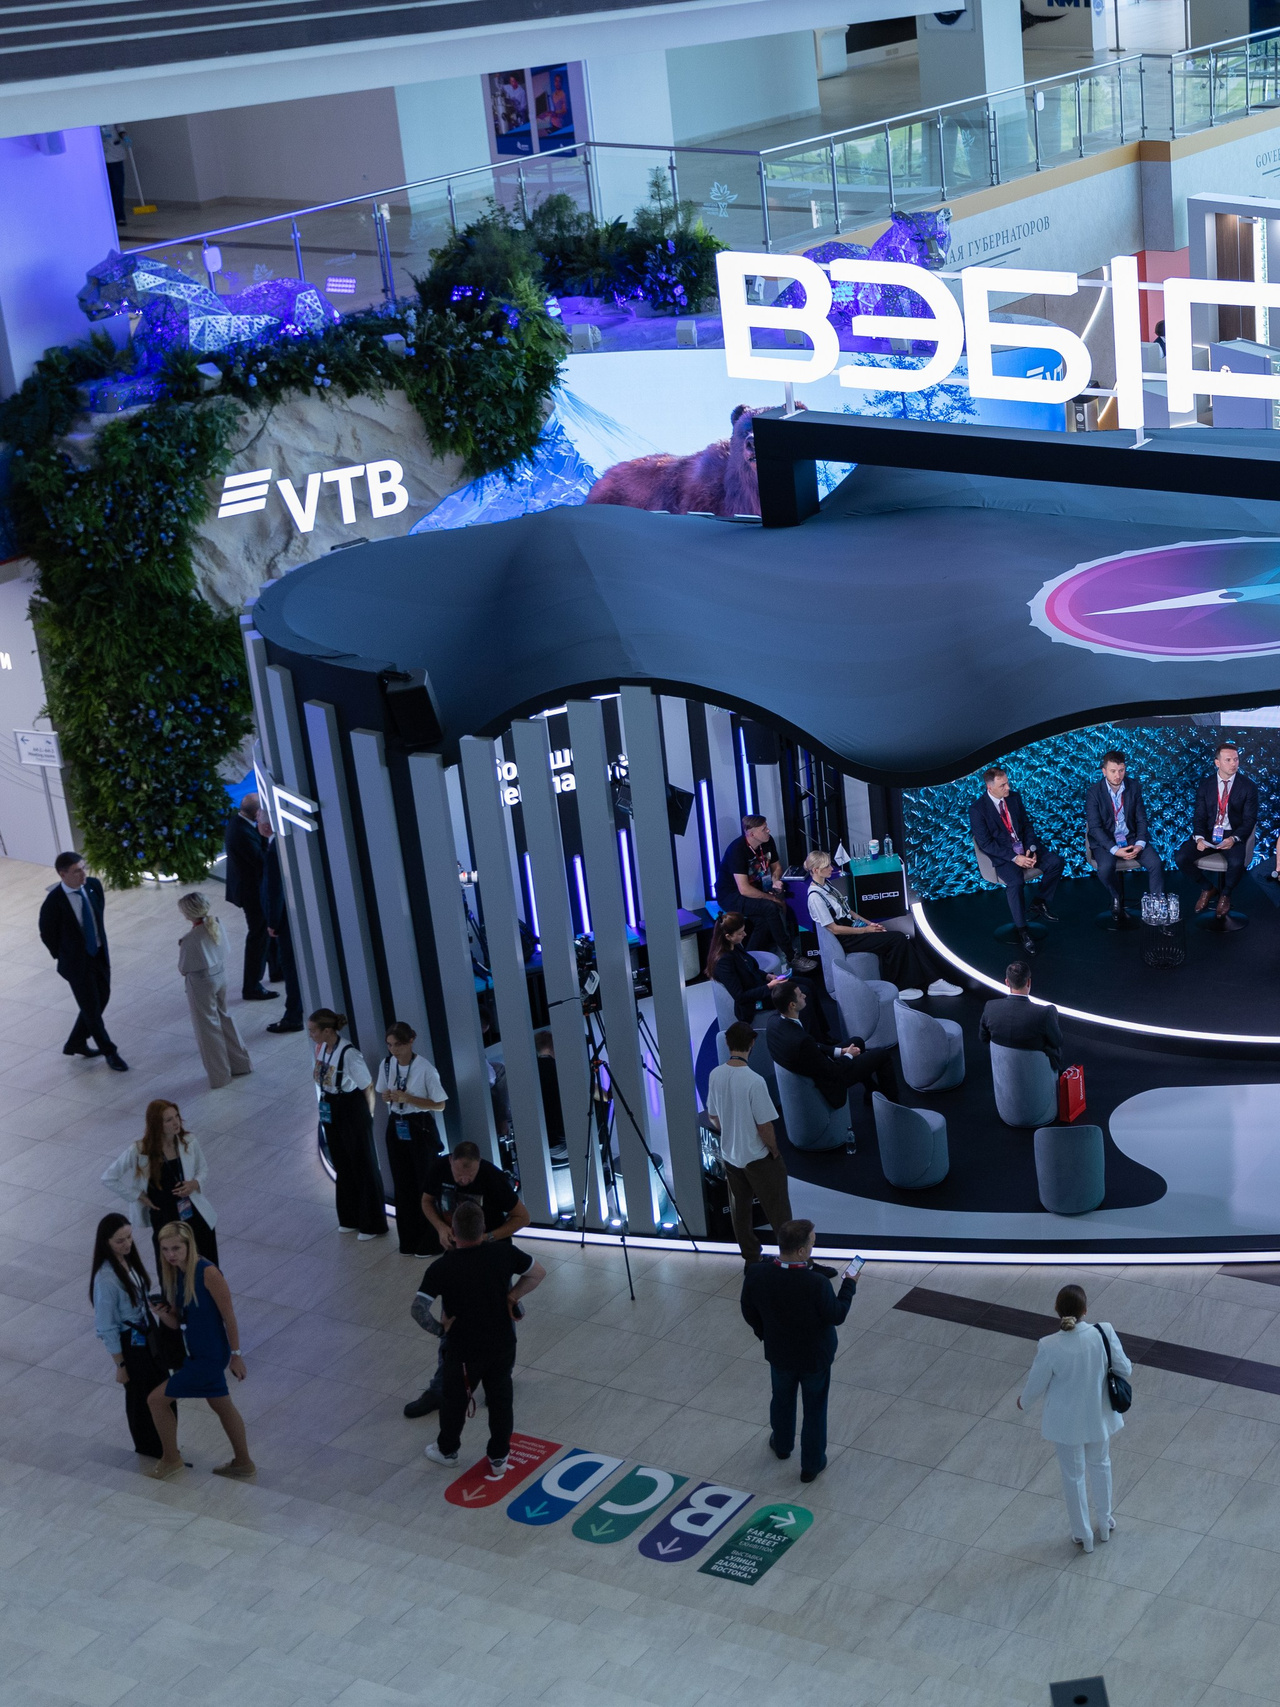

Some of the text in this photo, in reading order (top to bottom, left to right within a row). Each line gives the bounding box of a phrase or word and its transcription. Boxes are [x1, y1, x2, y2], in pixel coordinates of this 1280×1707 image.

[968, 216, 1050, 257] ГУБЕРНАТОРОВ
[277, 459, 409, 533] VTB
[541, 1453, 625, 1502] D
[598, 1468, 674, 1515] C
[670, 1485, 752, 1537] B
[745, 1535, 779, 1548] STREET
[746, 1527, 789, 1543] FAR EAST
[738, 1541, 775, 1553] EXHIBITION
[724, 1555, 757, 1567] «УЛИЦА
[731, 1549, 763, 1561] ВЫСТАВКА
[711, 1564, 752, 1579] ВОСТОКА»
[715, 1559, 759, 1574] ДАЛЬНЕГО
